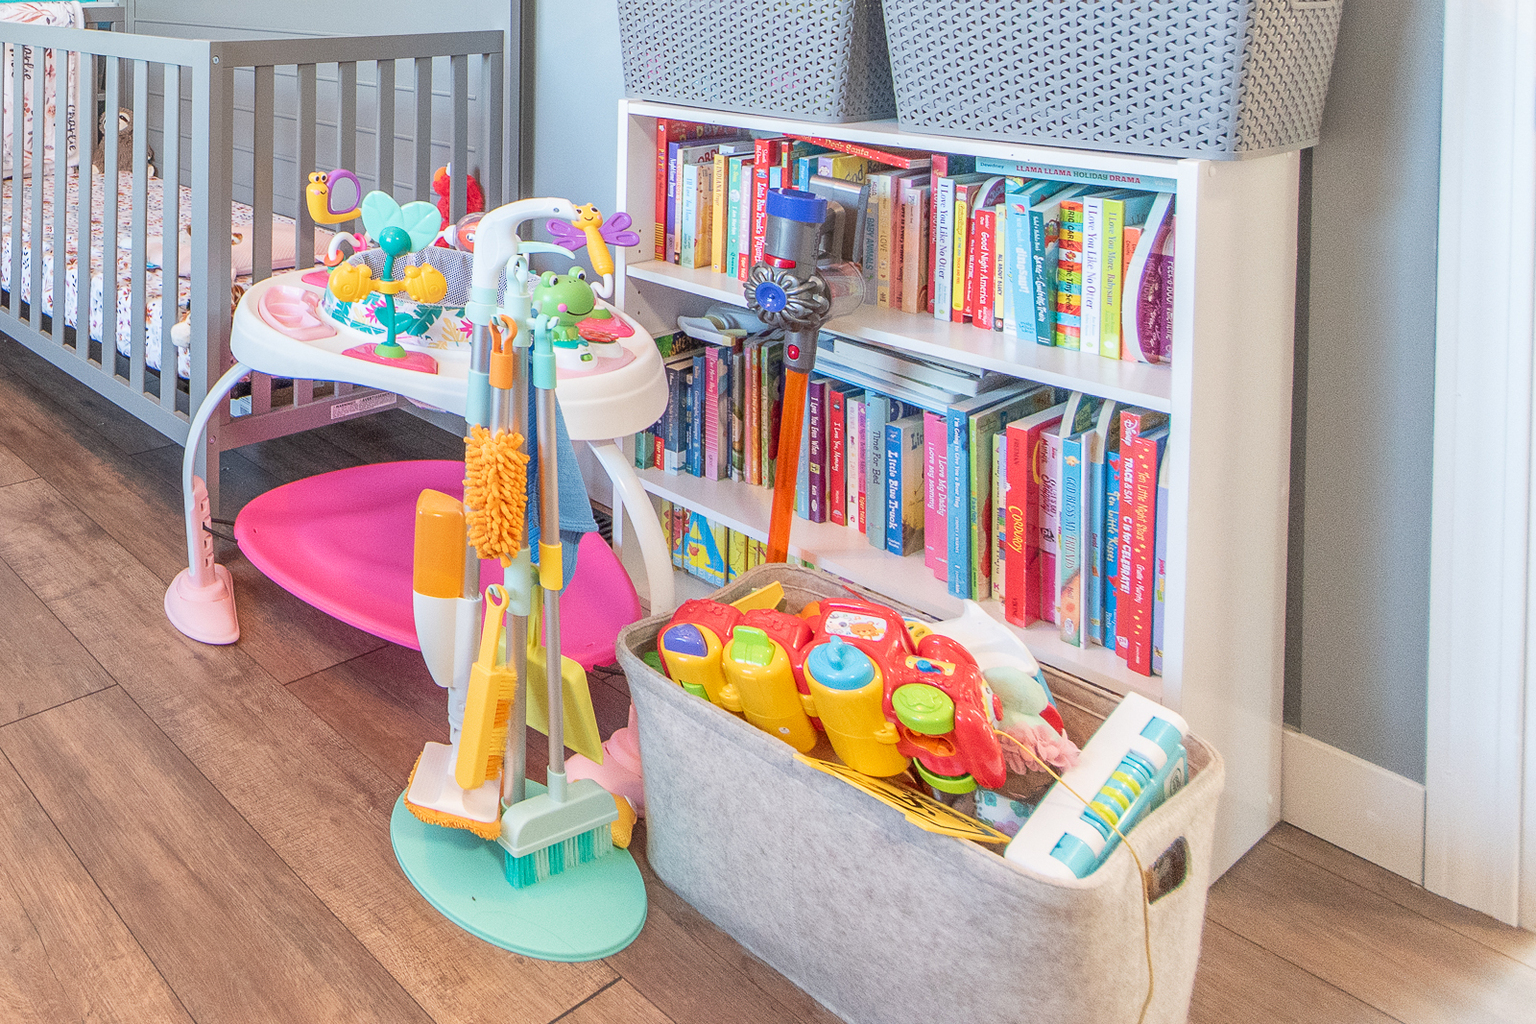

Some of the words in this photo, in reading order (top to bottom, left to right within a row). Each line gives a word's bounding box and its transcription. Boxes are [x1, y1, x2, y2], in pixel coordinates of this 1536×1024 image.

[847, 141, 870, 157] Santa
[979, 161, 1005, 172] Dewdney
[1016, 164, 1043, 175] LLAMA
[1043, 166, 1072, 178] LLAMA
[1072, 170, 1109, 181] HOLIDAY
[1109, 173, 1142, 185] DRAMA
[756, 199, 766, 211] Blue
[940, 190, 948, 207] Love
[940, 210, 948, 224] You
[1088, 211, 1097, 230] Love
[1108, 217, 1117, 234] Love
[866, 218, 874, 239] BABY
[939, 226, 947, 244] Like
[1067, 225, 1075, 248] CARLE
[981, 232, 990, 250] Good
[1087, 233, 1097, 248] You
[1107, 236, 1116, 250] You
[866, 240, 874, 270] ANIMALS
[939, 245, 947, 256] No
[938, 258, 946, 279] Otter
[979, 251, 989, 273] Night
[1087, 251, 1097, 269] Like
[1106, 252, 1116, 271] More,
[1016, 247, 1029, 293] dinosaur!
[1066, 265, 1074, 276] The
[1087, 271, 1096, 284] No
[979, 274, 988, 304] America
[1065, 278, 1073, 293] Tiny
[1104, 273, 1115, 306] Babysaur
[1086, 286, 1096, 309] Otter
[810, 402, 818, 414] Love
[811, 416, 819, 425] You
[811, 426, 819, 438] Even
[872, 430, 881, 450] Time
[1122, 418, 1138, 446] Disney
[811, 440, 820, 455] When
[832, 440, 840, 449] You,
[831, 450, 840, 471] Mommy
[872, 452, 881, 467] For
[887, 450, 897, 477] Little
[872, 468, 881, 485] Bed
[927, 465, 935, 478] My
[938, 460, 946, 478] Love
[1124, 457, 1134, 483] TRACE
[1137, 471, 1150, 484] Ten
[889, 479, 898, 499] Blue
[937, 479, 946, 492] My
[1065, 476, 1076, 493] GOD
[1136, 484, 1149, 501] Little
[927, 479, 935, 509] Mommy
[1107, 491, 1120, 507] Ten
[1123, 490, 1133, 505] SAY
[888, 499, 898, 529] Truck
[937, 493, 946, 517] Daddy
[1065, 495, 1076, 518] BLESS
[1135, 502, 1148, 522] Night
[1065, 519, 1076, 534] MY
[1107, 509, 1120, 535] Little
[1123, 515, 1133, 524] C
[1007, 506, 1024, 554] CORDUROY
[1122, 531, 1133, 543] for
[1135, 523, 1147, 541] Stars
[1065, 535, 1076, 570] FRIENDS
[1106, 536, 1119, 563] Kisses
[1120, 544, 1132, 594] CELEBRATE!
[1133, 584, 1144, 604] Murphy
